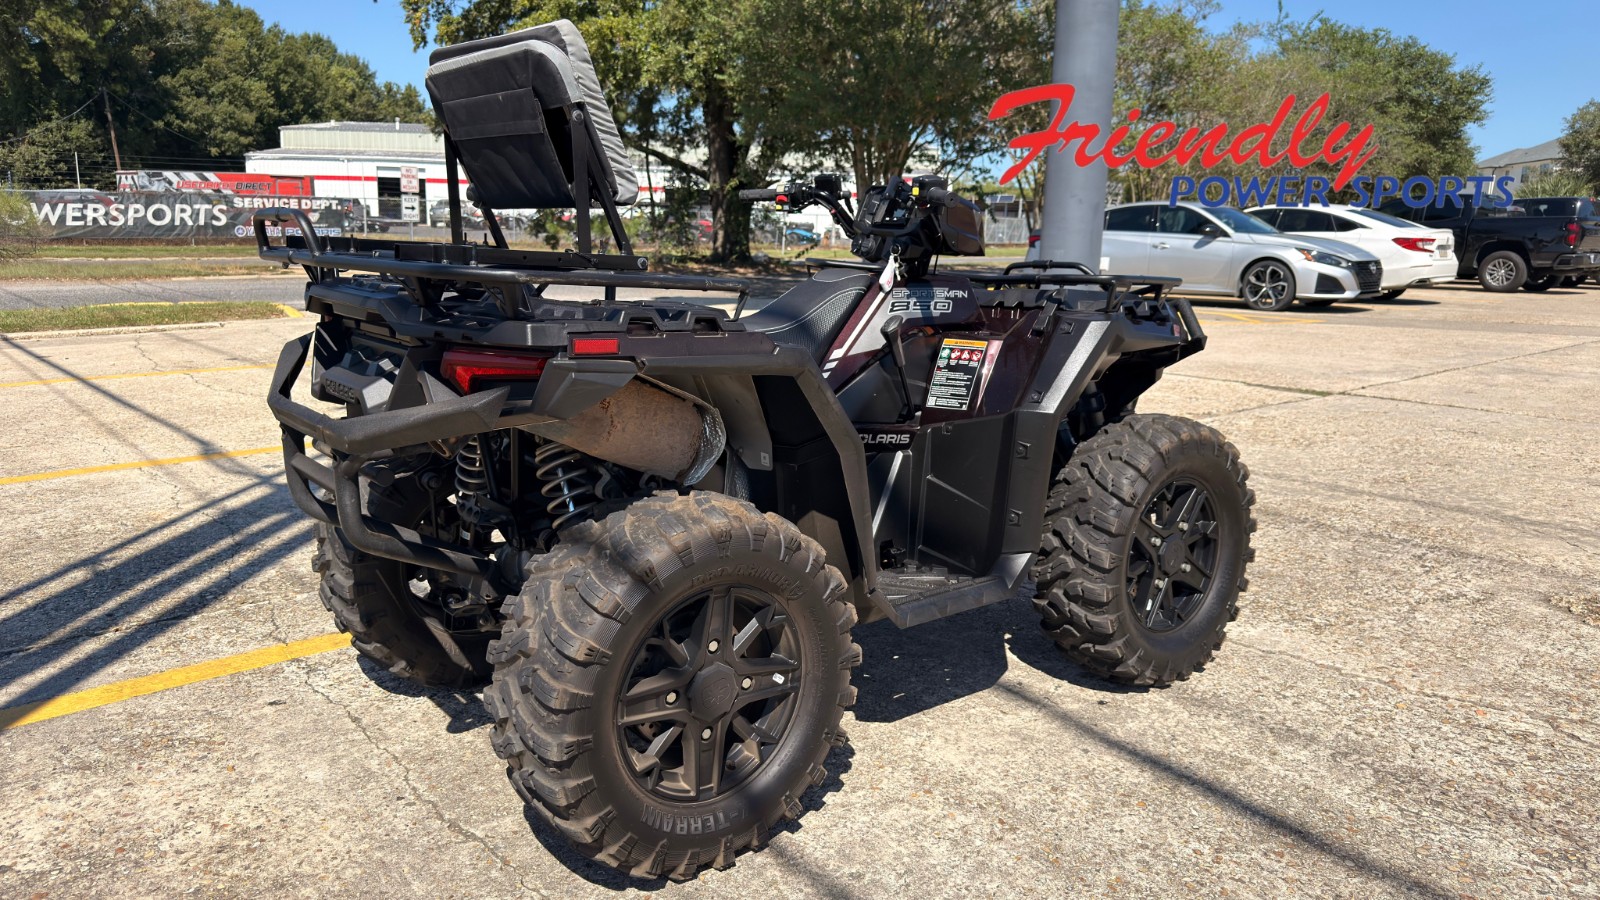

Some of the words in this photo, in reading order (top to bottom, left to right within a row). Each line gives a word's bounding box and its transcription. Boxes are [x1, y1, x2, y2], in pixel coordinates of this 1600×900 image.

[233, 197, 299, 209] SERVICE
[303, 199, 342, 210] DEPT.
[246, 226, 282, 237] YAAHA
[285, 228, 342, 236] POARIS
[892, 290, 968, 299] SPORTSMAN
[888, 300, 953, 315] 850
[858, 433, 910, 444] OLARIS
[640, 802, 746, 836] -TERRAIN
